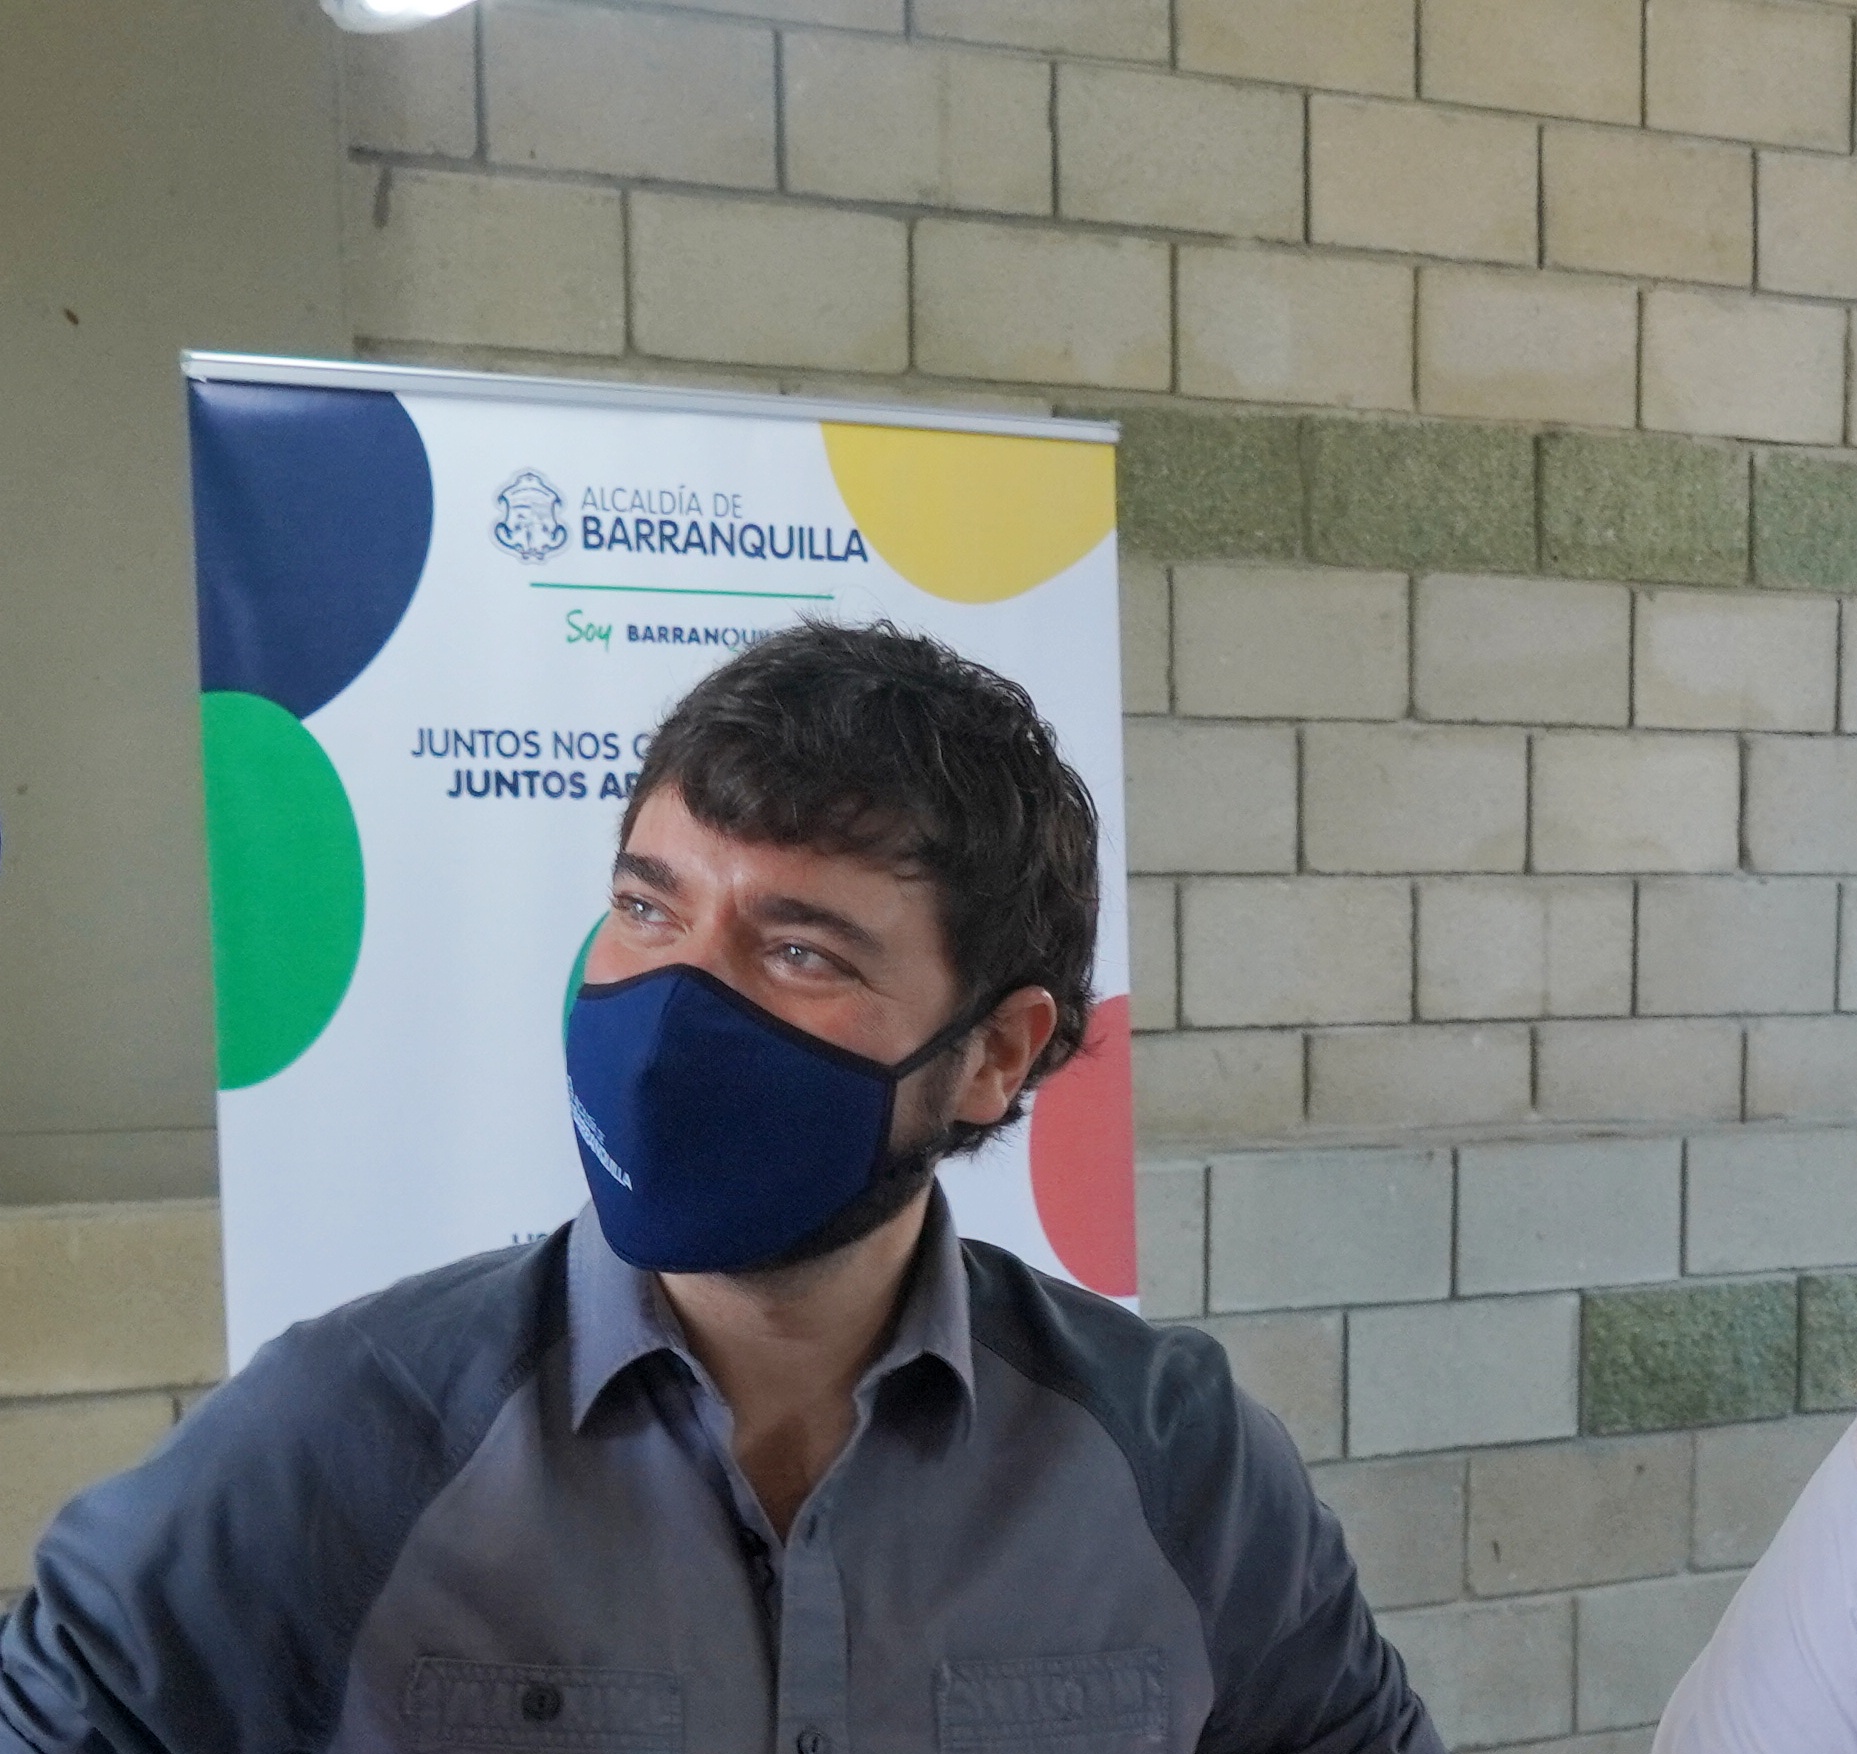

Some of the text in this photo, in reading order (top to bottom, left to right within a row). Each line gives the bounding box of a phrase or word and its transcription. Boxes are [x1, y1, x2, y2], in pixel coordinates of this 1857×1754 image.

[581, 485, 743, 519] ALCALDÍA DE
[581, 515, 869, 563] BARRANQUILLA
[566, 609, 612, 652] Soy
[411, 727, 542, 759] JUNTOS
[553, 731, 620, 760] NOS
[447, 769, 587, 799] JUNTOS
